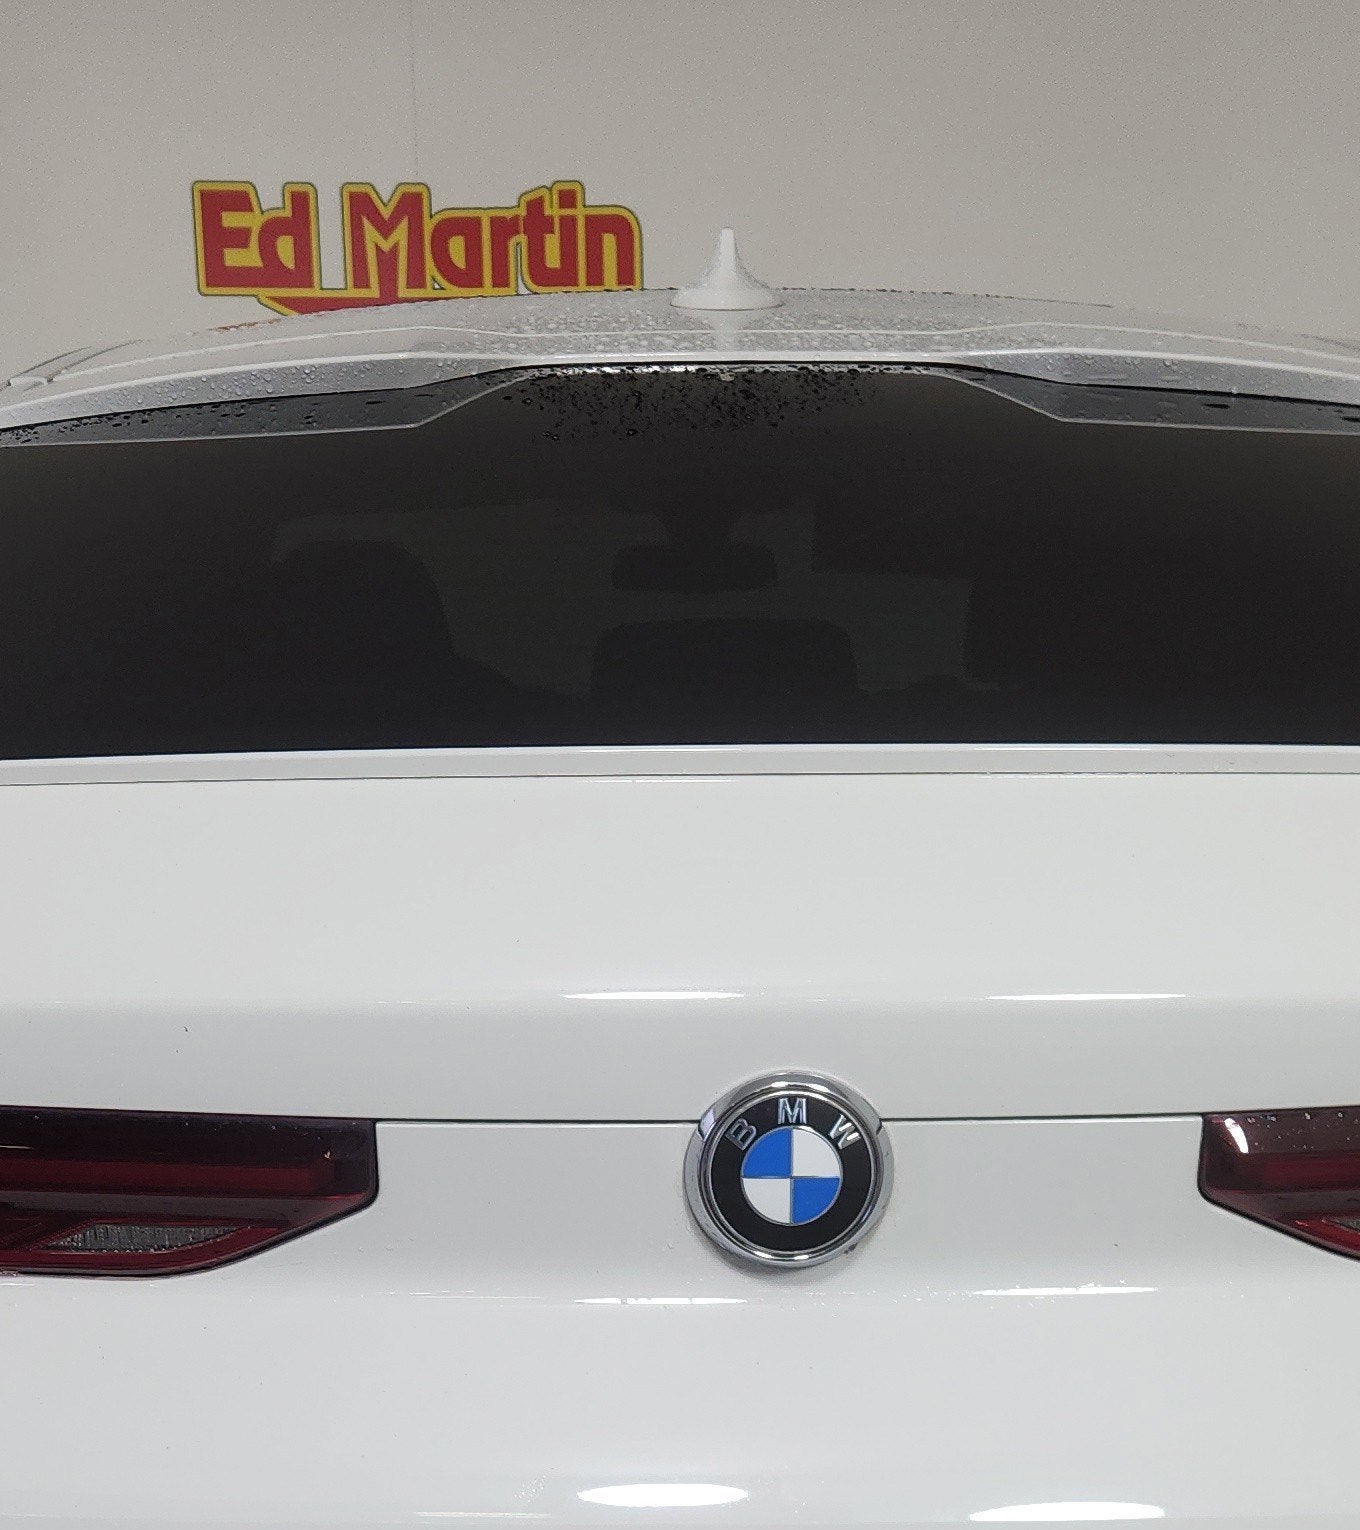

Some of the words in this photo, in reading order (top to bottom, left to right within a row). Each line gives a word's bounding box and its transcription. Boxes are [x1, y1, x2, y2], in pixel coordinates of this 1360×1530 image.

[192, 181, 322, 296] Ed
[339, 181, 644, 298] Martin
[725, 1097, 861, 1151] BMW
